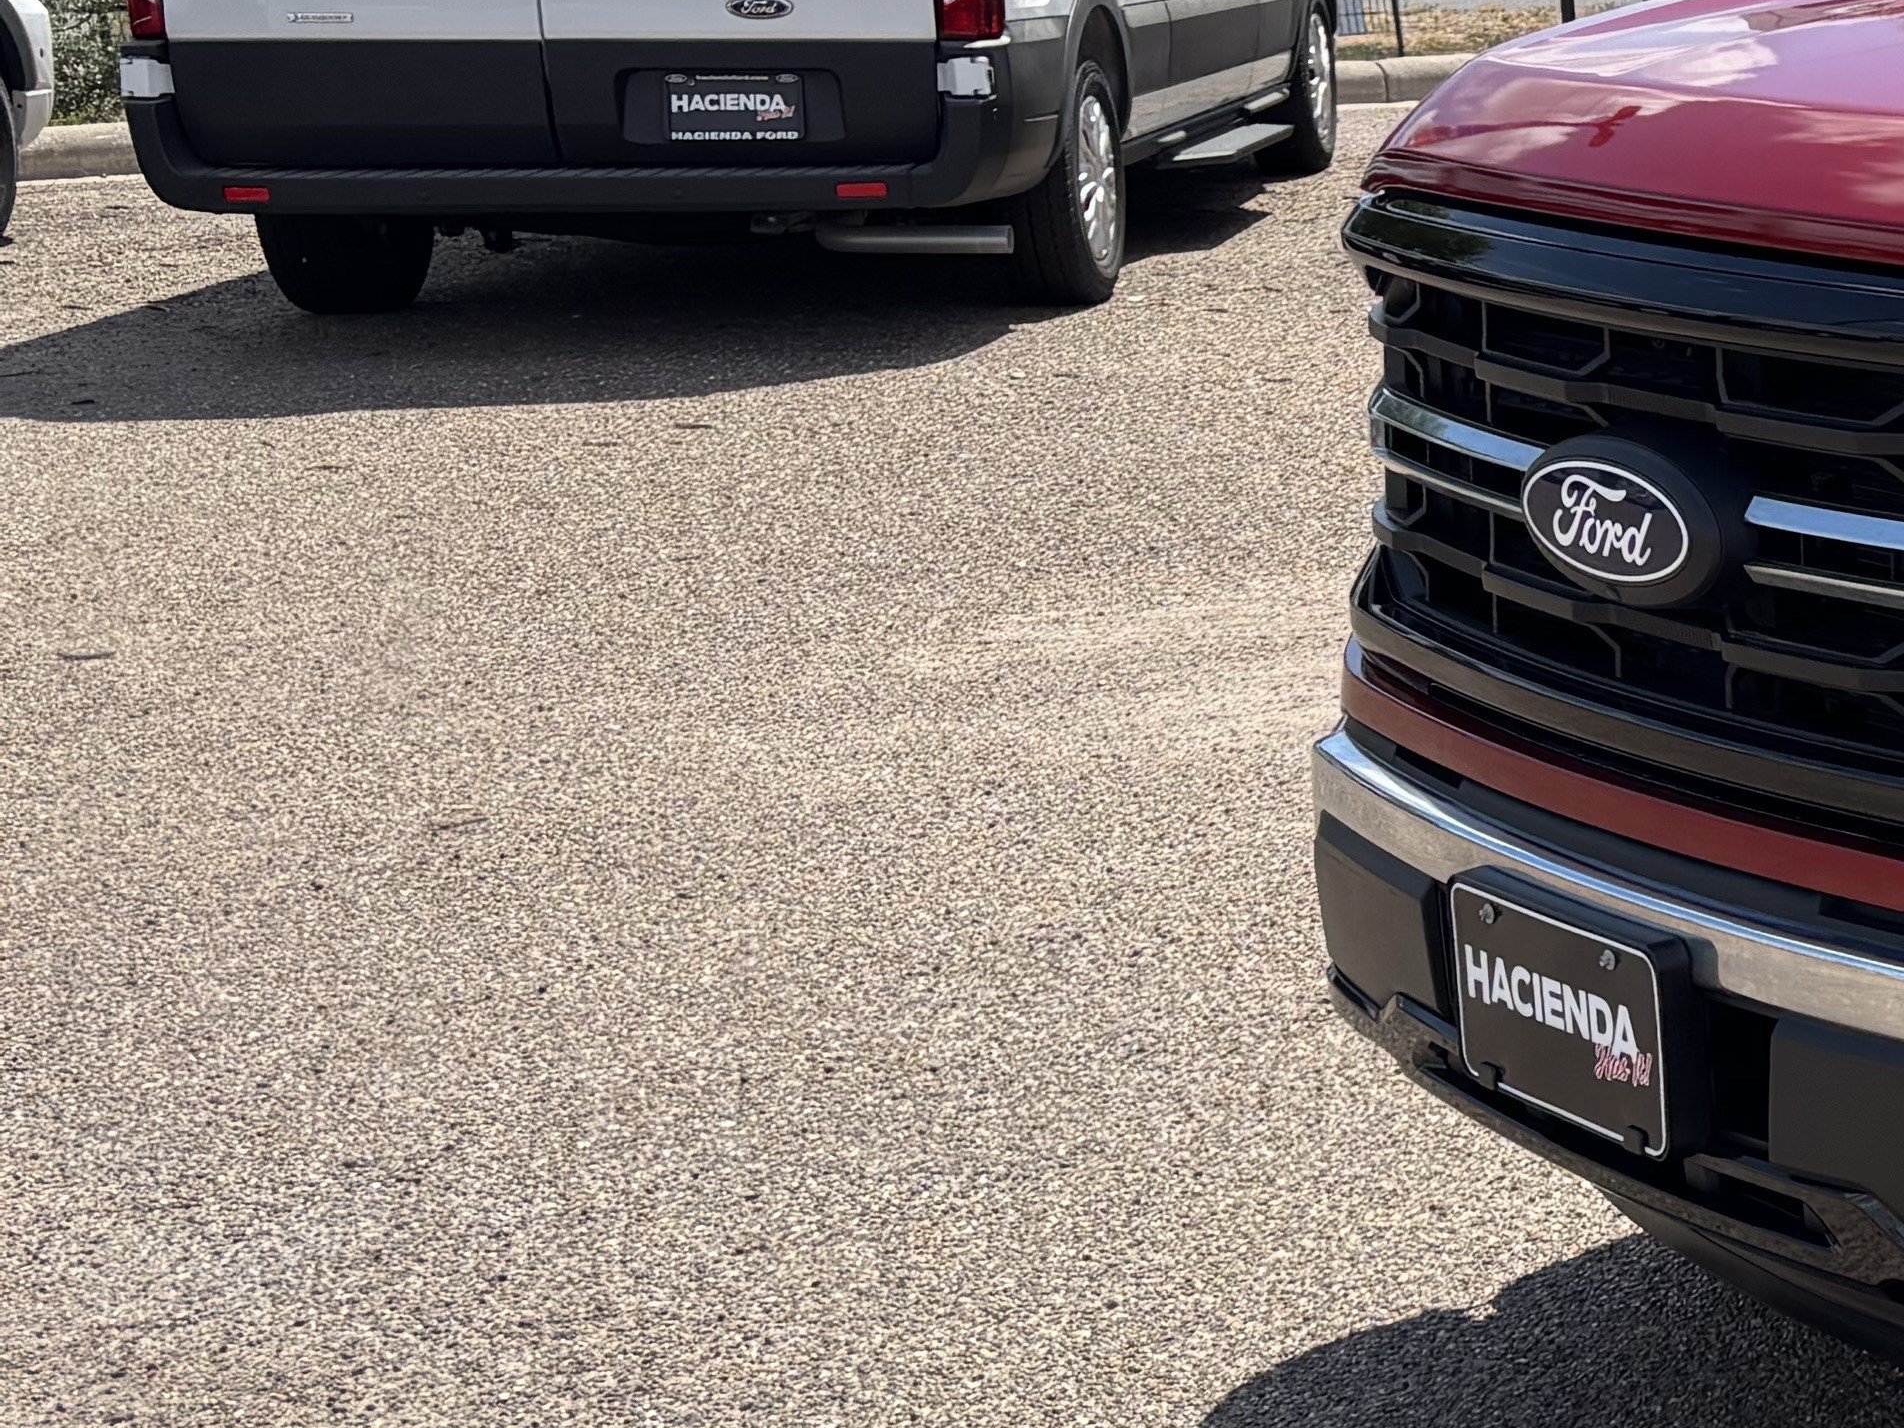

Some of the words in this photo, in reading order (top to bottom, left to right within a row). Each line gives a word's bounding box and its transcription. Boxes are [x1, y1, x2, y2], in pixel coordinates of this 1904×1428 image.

[671, 93, 786, 113] HACIENDA
[671, 131, 753, 141] HACIENDA
[756, 130, 799, 141] FORD
[1552, 473, 1653, 567] Ford
[1464, 943, 1640, 1056] HACIENDA
